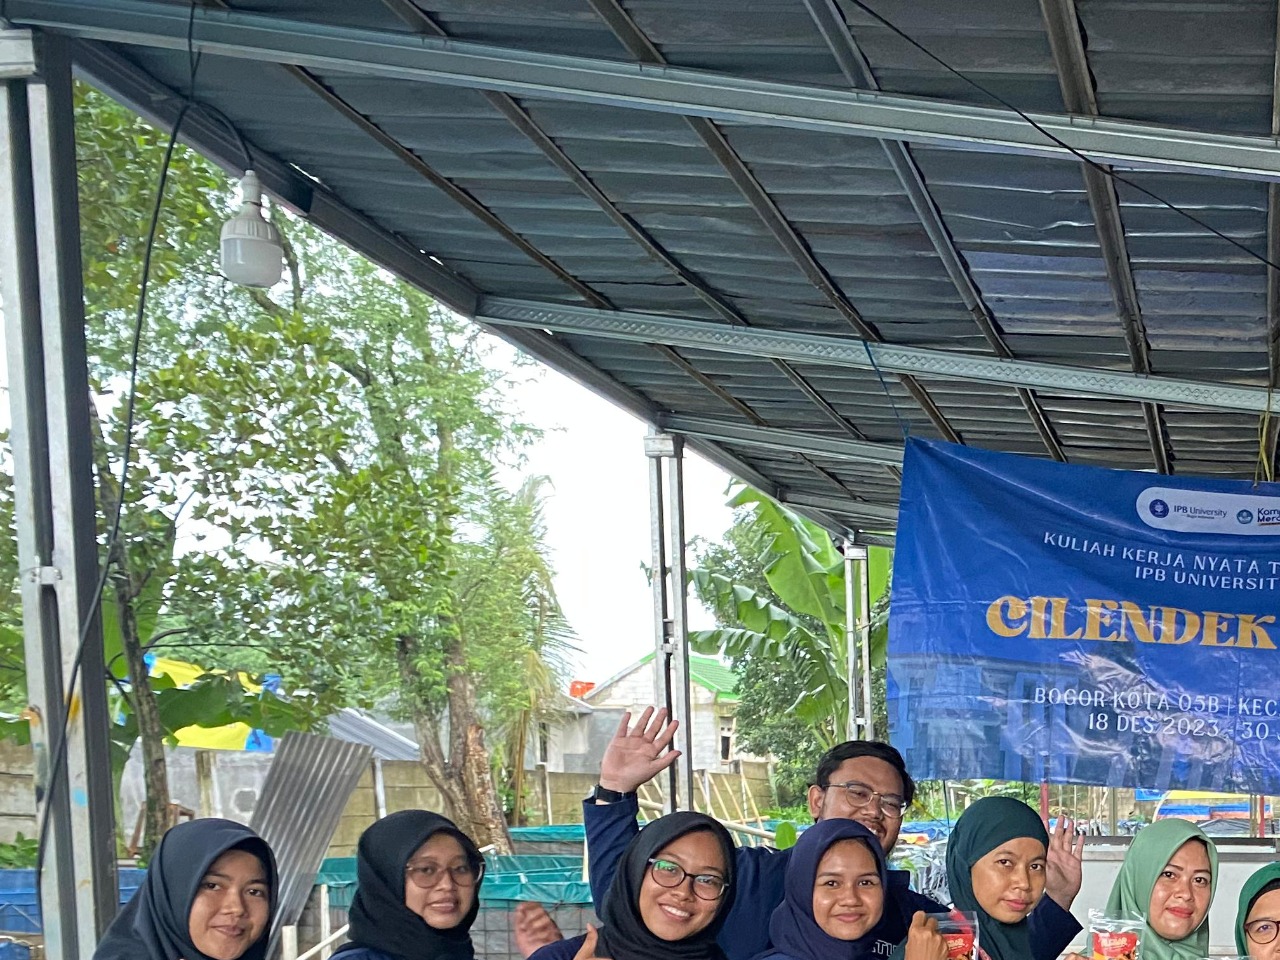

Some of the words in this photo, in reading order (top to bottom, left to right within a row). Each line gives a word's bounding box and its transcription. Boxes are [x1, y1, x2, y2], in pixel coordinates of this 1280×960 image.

[1173, 505, 1188, 514] IPB
[1189, 506, 1227, 518] University
[1043, 531, 1115, 557] KULIAH
[1122, 547, 1185, 569] KERJA
[1193, 555, 1259, 574] NYATA
[1135, 566, 1166, 582] IPB
[985, 595, 1278, 650] CILENDEK
[1034, 687, 1105, 707] BOGOR
[1113, 692, 1170, 710] KOTA
[1088, 712, 1108, 731] 18
[1116, 715, 1155, 734] DES
[1162, 717, 1219, 737] 2023
[1241, 722, 1269, 740] 30
